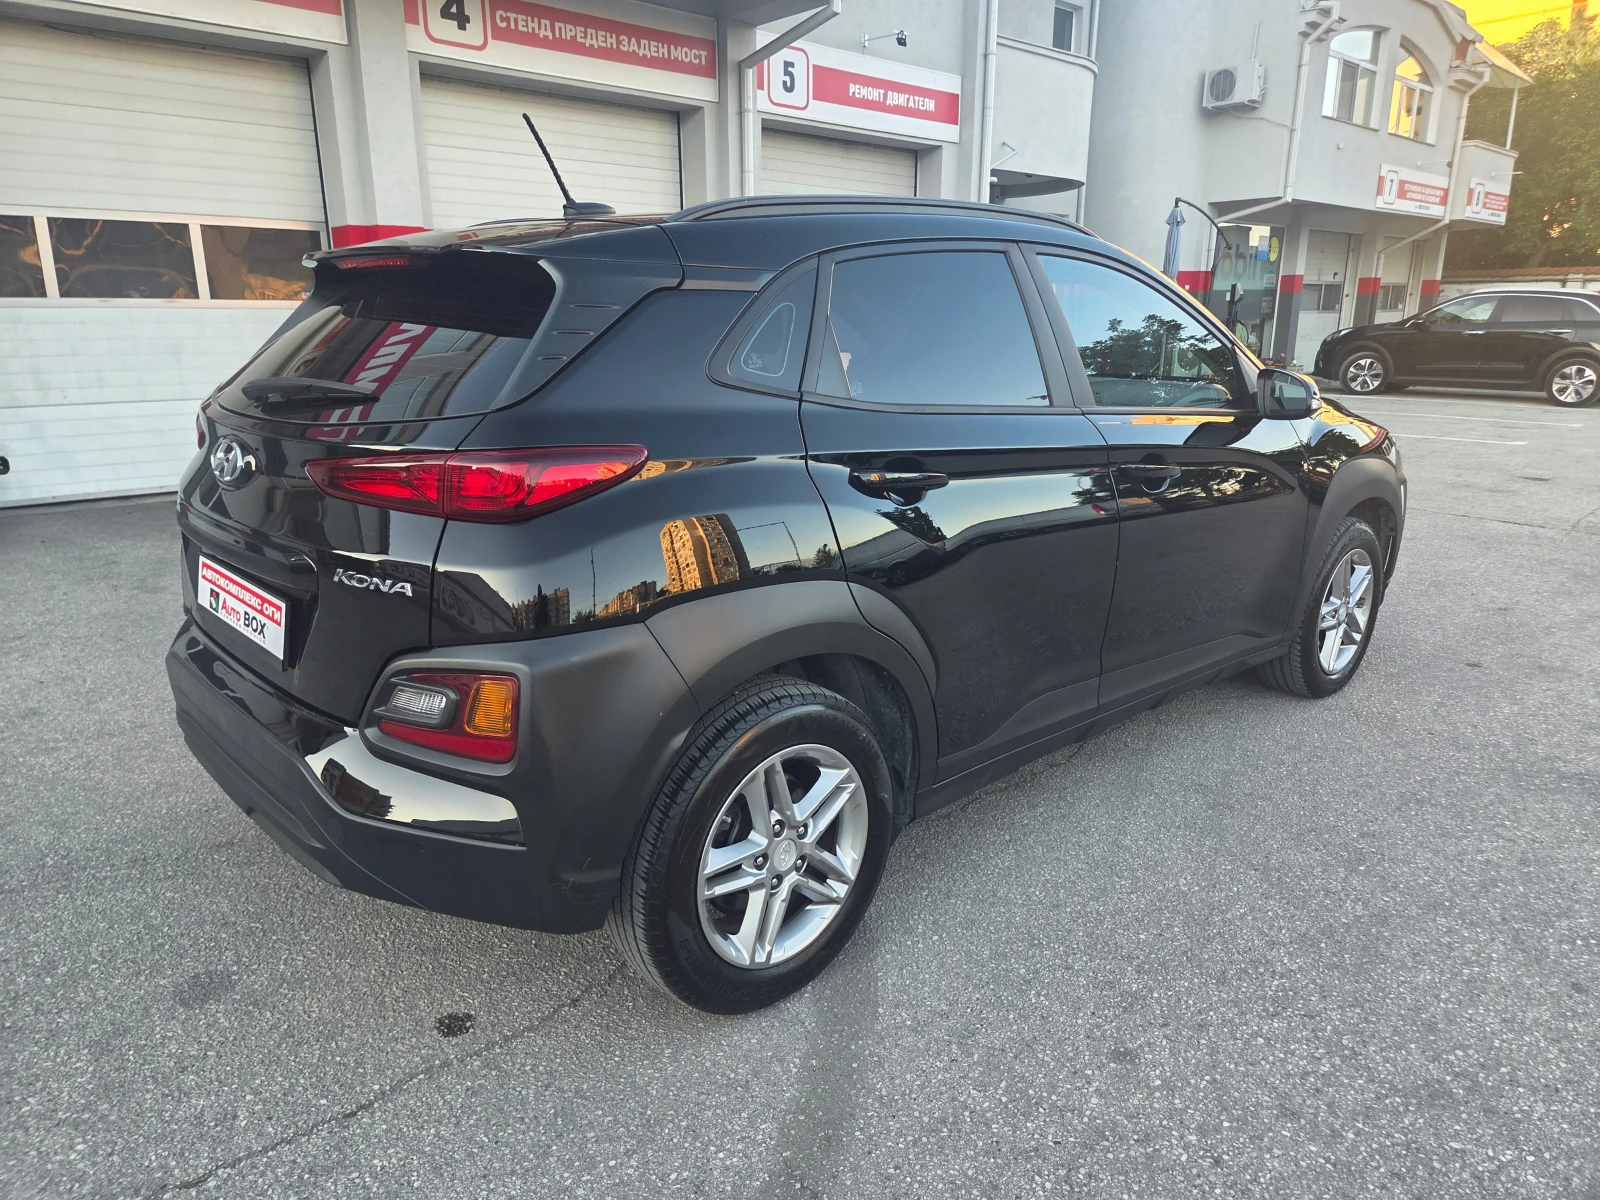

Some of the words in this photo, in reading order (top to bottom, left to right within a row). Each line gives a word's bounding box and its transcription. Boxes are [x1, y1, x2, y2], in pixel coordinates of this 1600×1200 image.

[440, 0, 470, 31] 4
[495, 10, 553, 40] СТЕНД
[554, 21, 617, 49] ПРЕДЕН
[619, 35, 668, 58] ЗАДЕН
[670, 44, 708, 65] МОСТ
[782, 60, 796, 93] 5
[849, 83, 885, 103] РЕМОНТ
[886, 90, 936, 112] ДВИГАТЕЛИ
[1388, 178, 1395, 197] 7
[202, 566, 262, 610] АВТОКОМПЛЕКС
[263, 602, 281, 622] ОГИ
[333, 568, 413, 597] KONA
[244, 609, 267, 640] BOX
